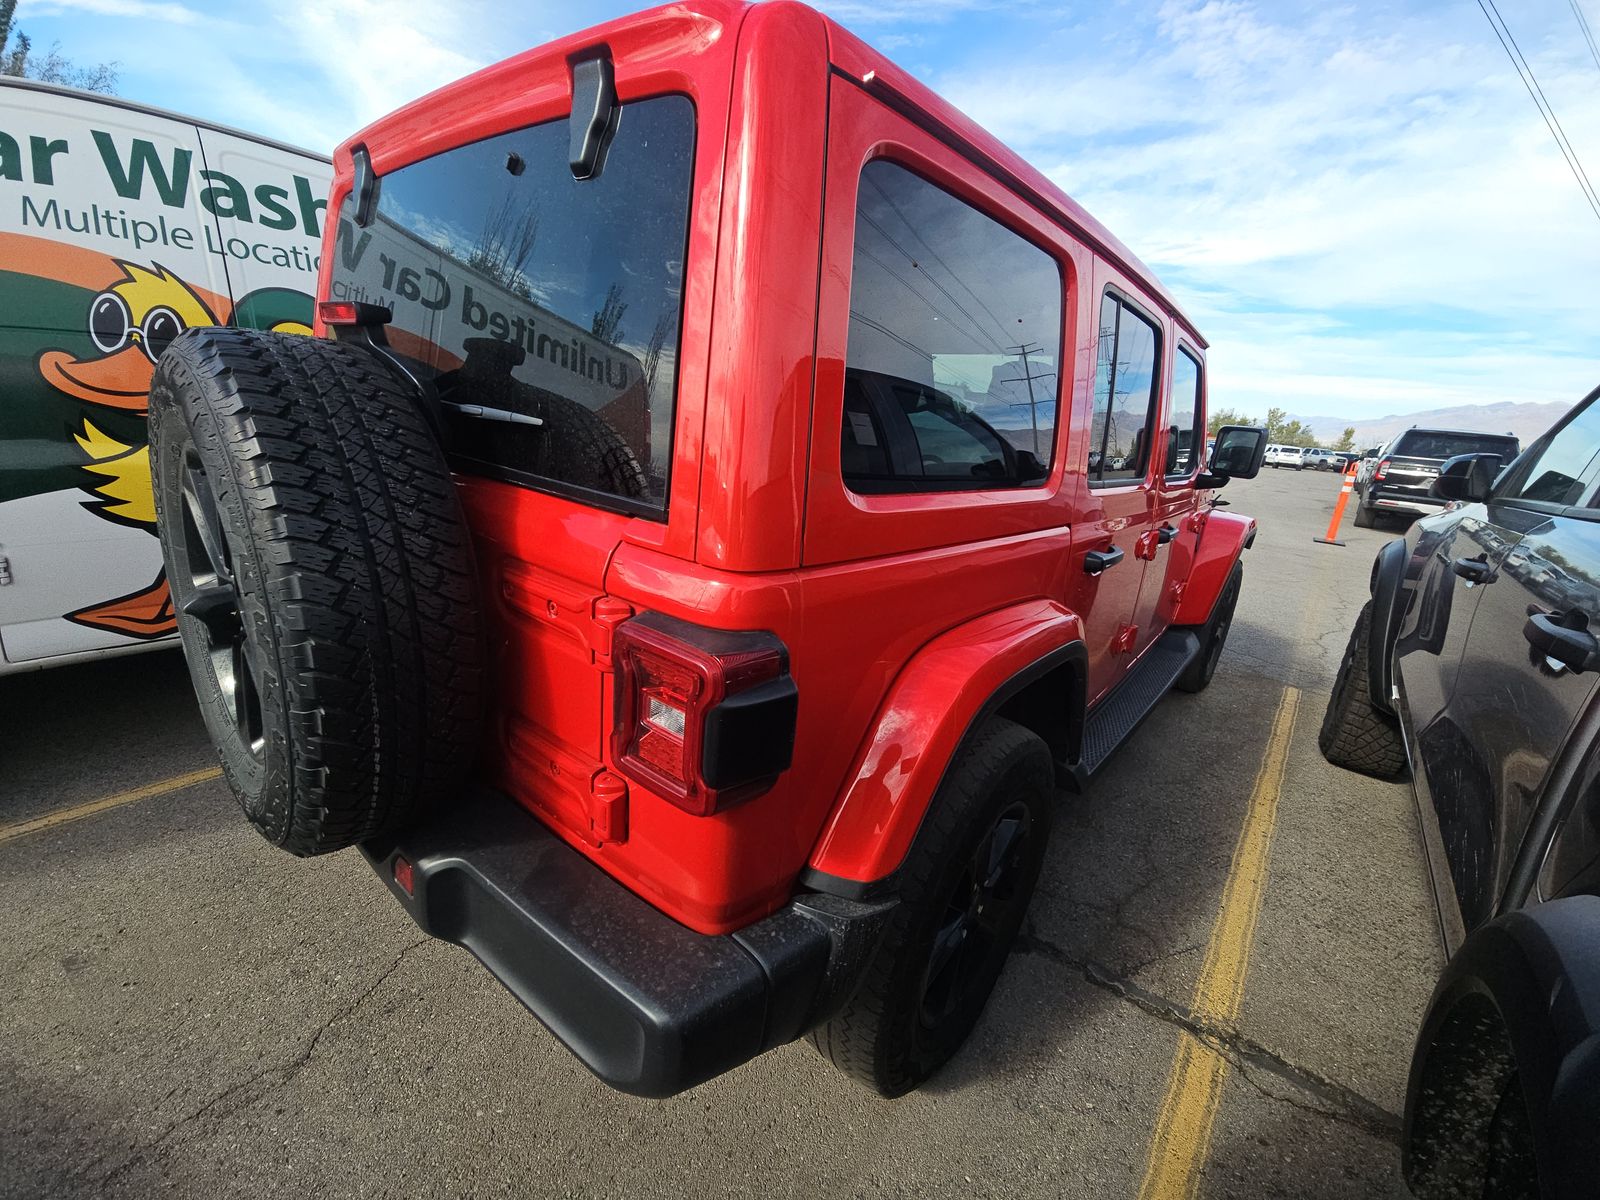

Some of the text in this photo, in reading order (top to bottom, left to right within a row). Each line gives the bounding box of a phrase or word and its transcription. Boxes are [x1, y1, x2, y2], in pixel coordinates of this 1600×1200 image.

[90, 128, 328, 238] Wash
[22, 195, 321, 272] Multiple Locati
